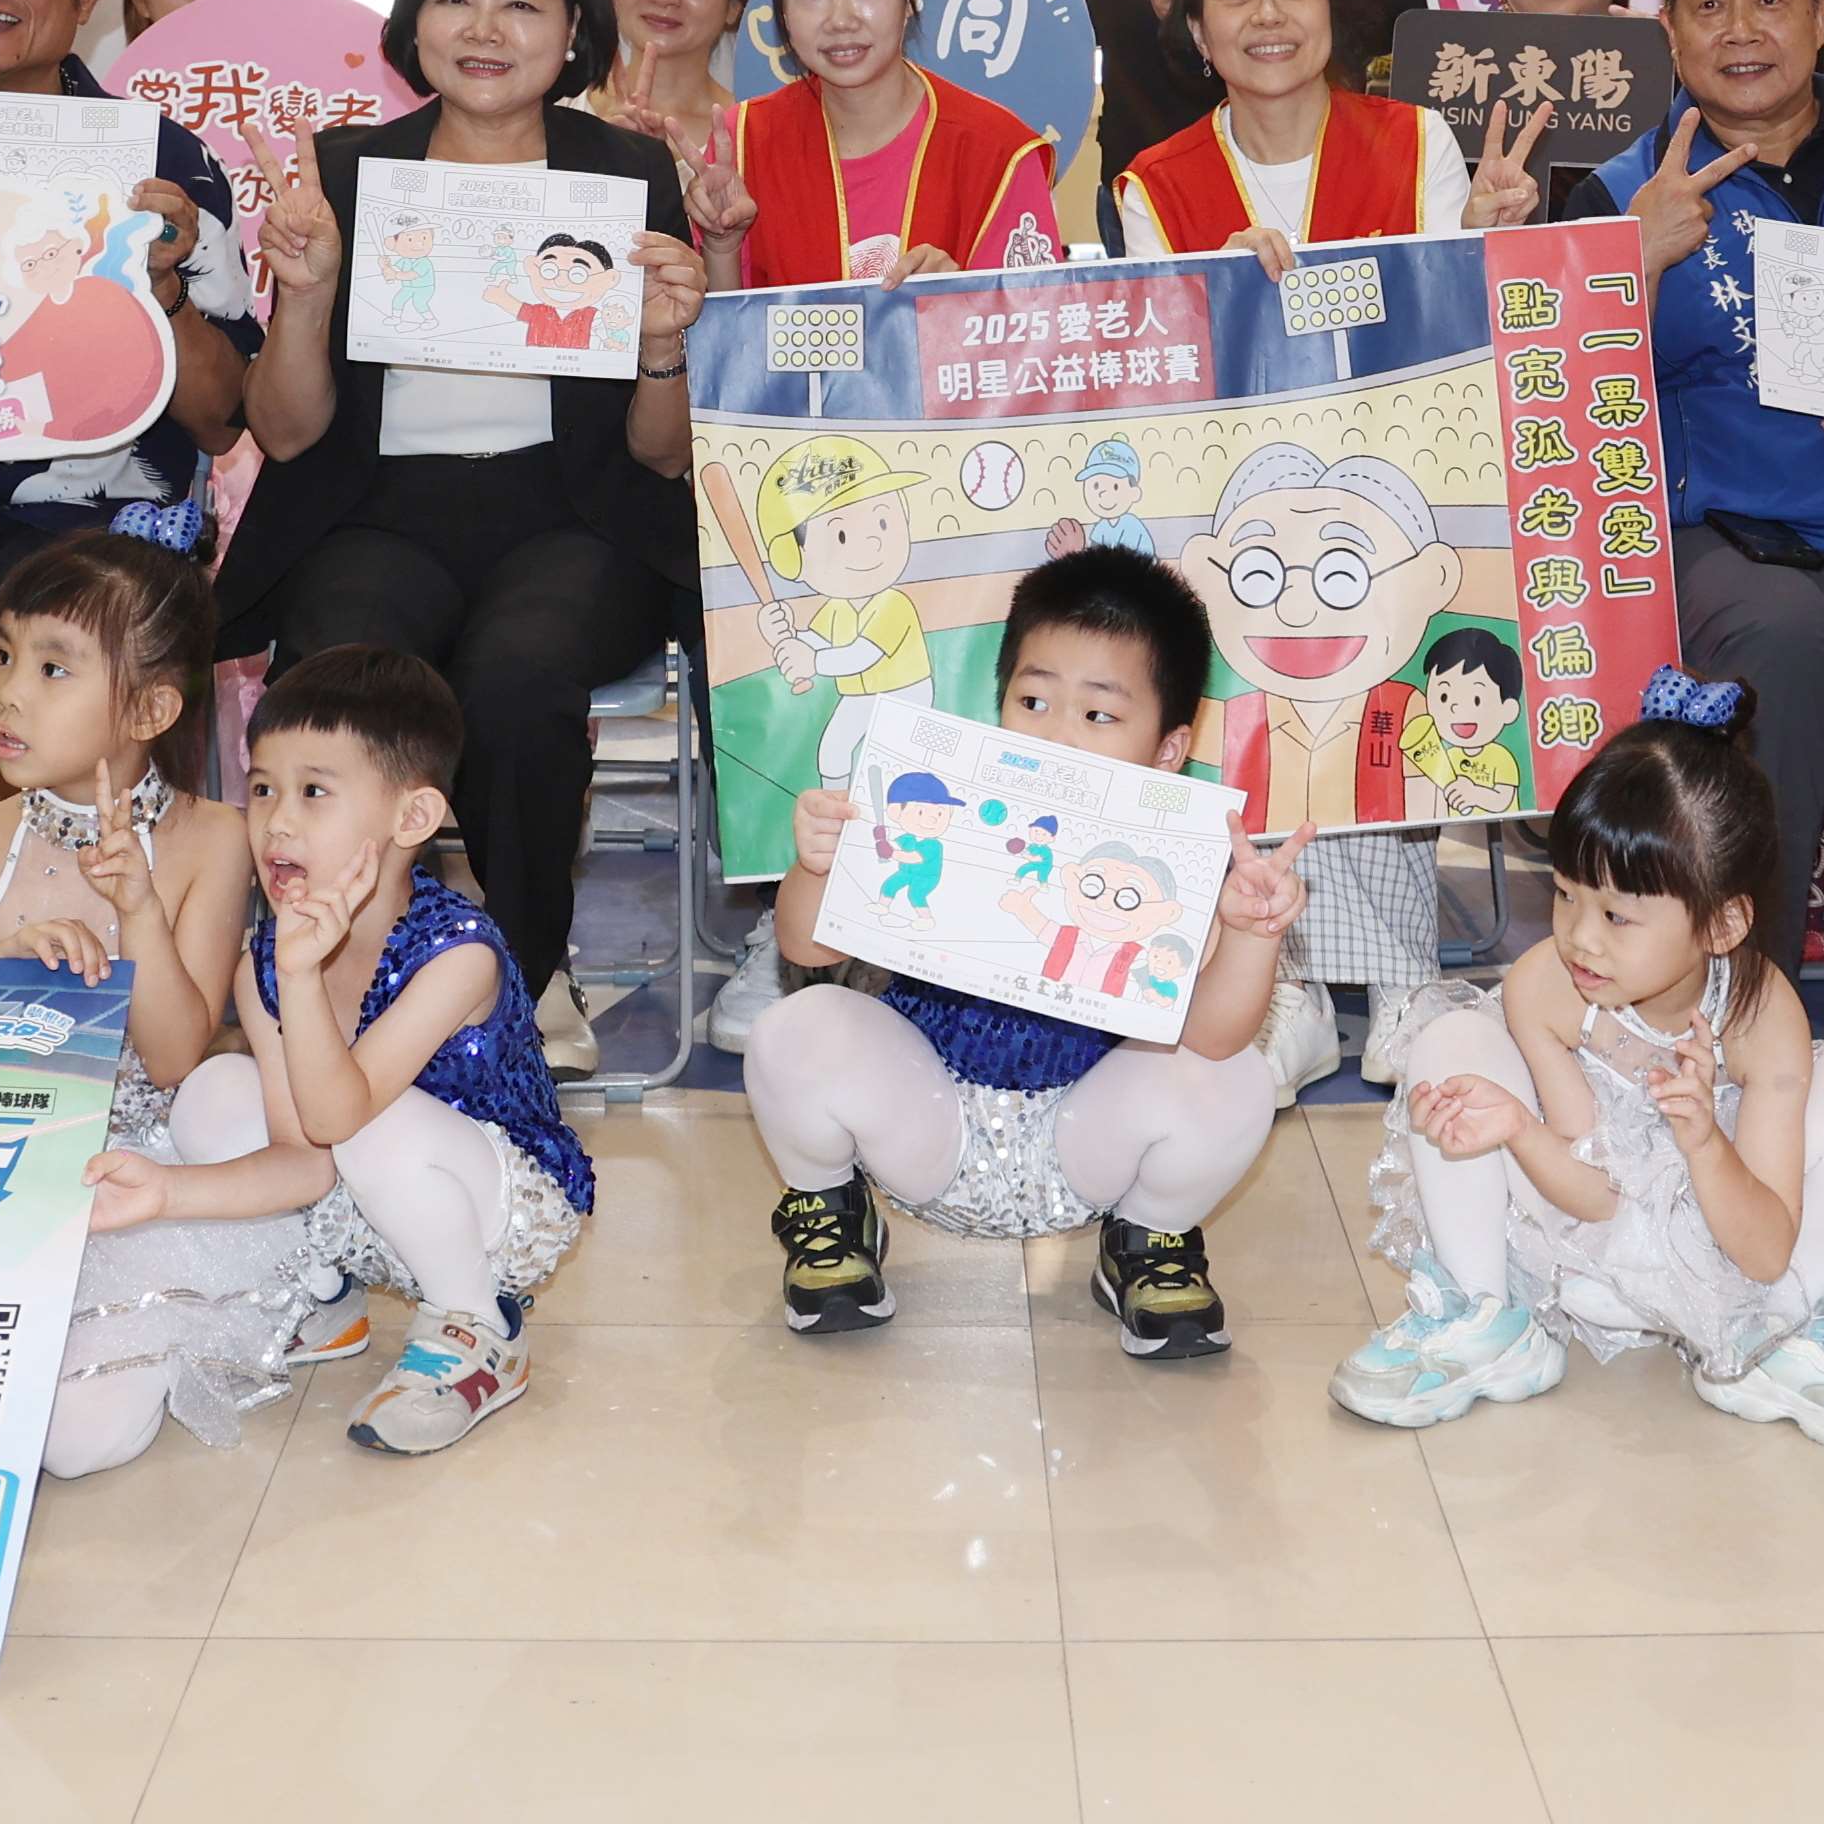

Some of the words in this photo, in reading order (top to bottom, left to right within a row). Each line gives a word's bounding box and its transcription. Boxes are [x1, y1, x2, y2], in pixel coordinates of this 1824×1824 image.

[1427, 42, 1635, 111] 新東陽
[1567, 111, 1633, 134] YANG
[936, 347, 1202, 401] 明星公益棒球賽
[1498, 277, 1601, 754] 點亮孤老與偏鄉
[1369, 709, 1394, 768] 華山
[783, 1194, 827, 1219] FILA
[1146, 1231, 1185, 1250] FILA
